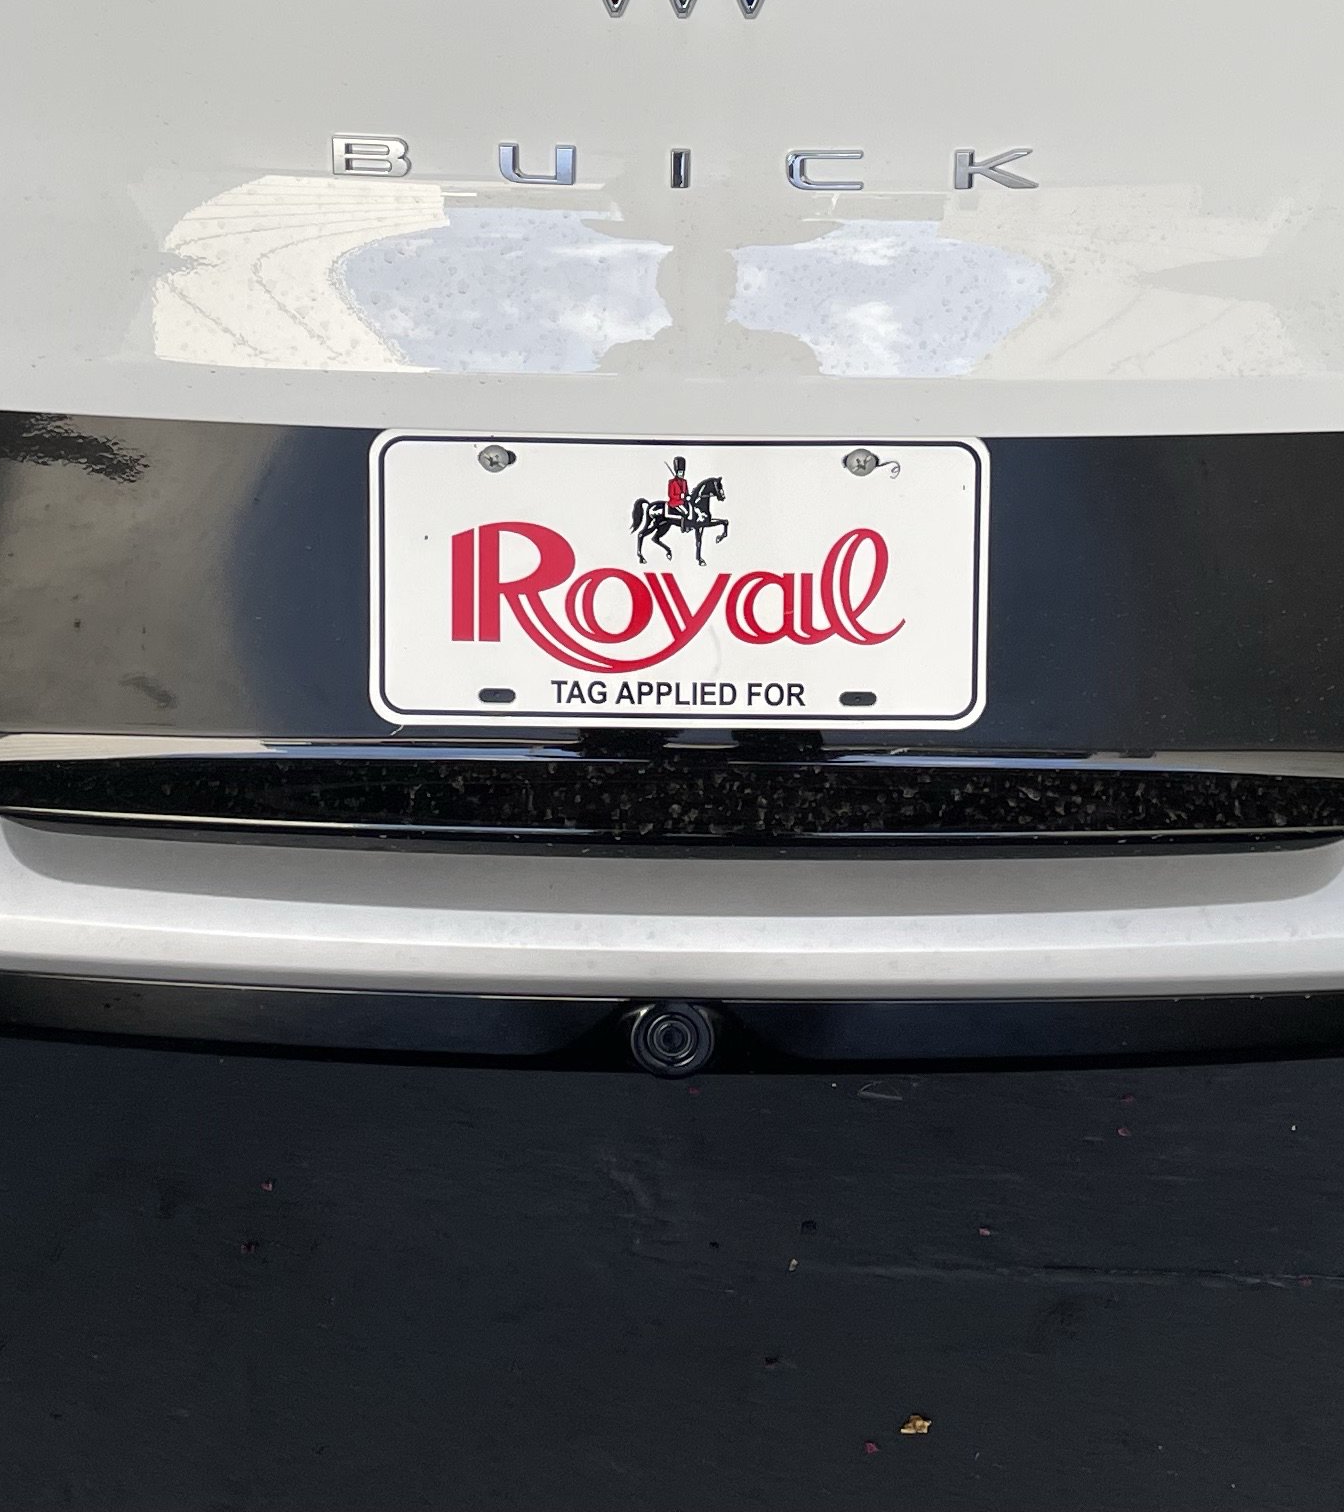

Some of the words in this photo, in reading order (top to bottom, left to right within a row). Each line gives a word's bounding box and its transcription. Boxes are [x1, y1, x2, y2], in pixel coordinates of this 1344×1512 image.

[331, 133, 1040, 191] BUICK
[451, 521, 906, 674] Royal
[550, 679, 608, 706] TAG
[615, 680, 737, 707] APPLIED
[745, 682, 806, 708] FOR
